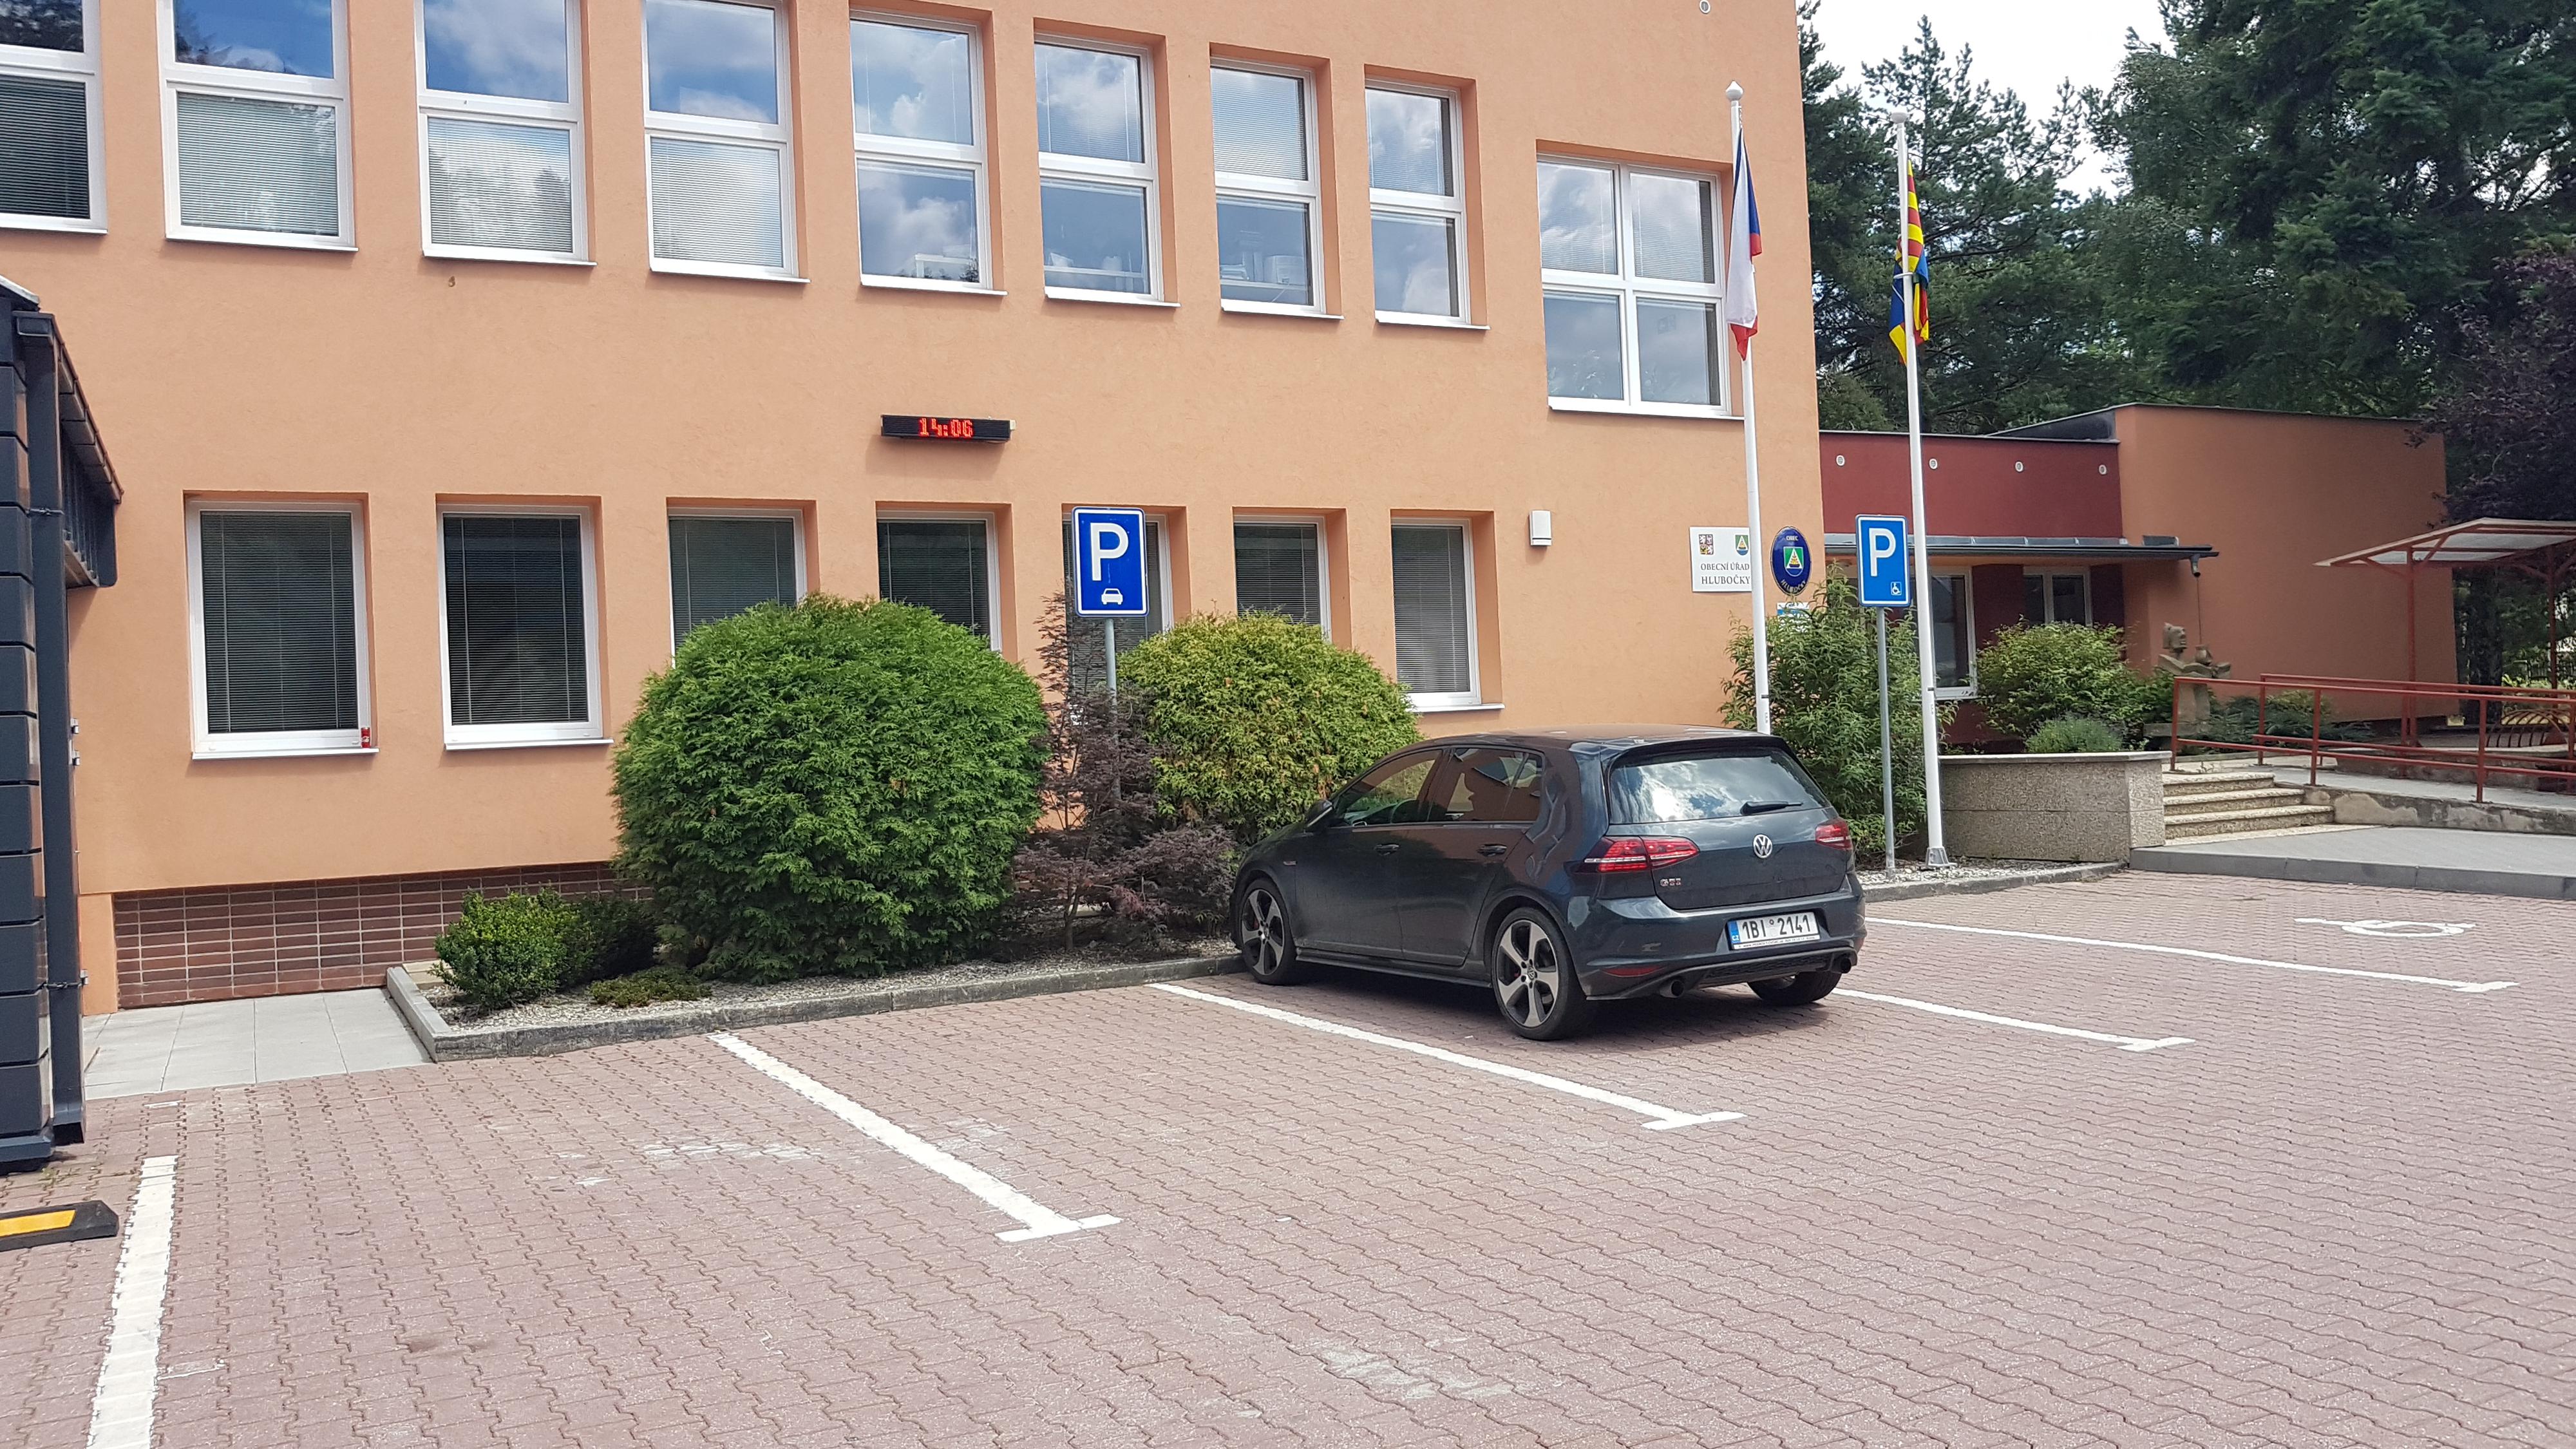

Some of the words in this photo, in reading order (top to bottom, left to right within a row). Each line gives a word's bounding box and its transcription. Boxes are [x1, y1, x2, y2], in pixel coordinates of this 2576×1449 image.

[918, 417, 973, 438] 14:06
[1090, 522, 1129, 582] P
[1869, 527, 1897, 577] P
[1700, 562, 1728, 571] OBECNÍ
[1730, 562, 1750, 571] ÚŘAD
[1701, 574, 1750, 585] HLUBOČKY
[1777, 914, 1810, 936] 2141
